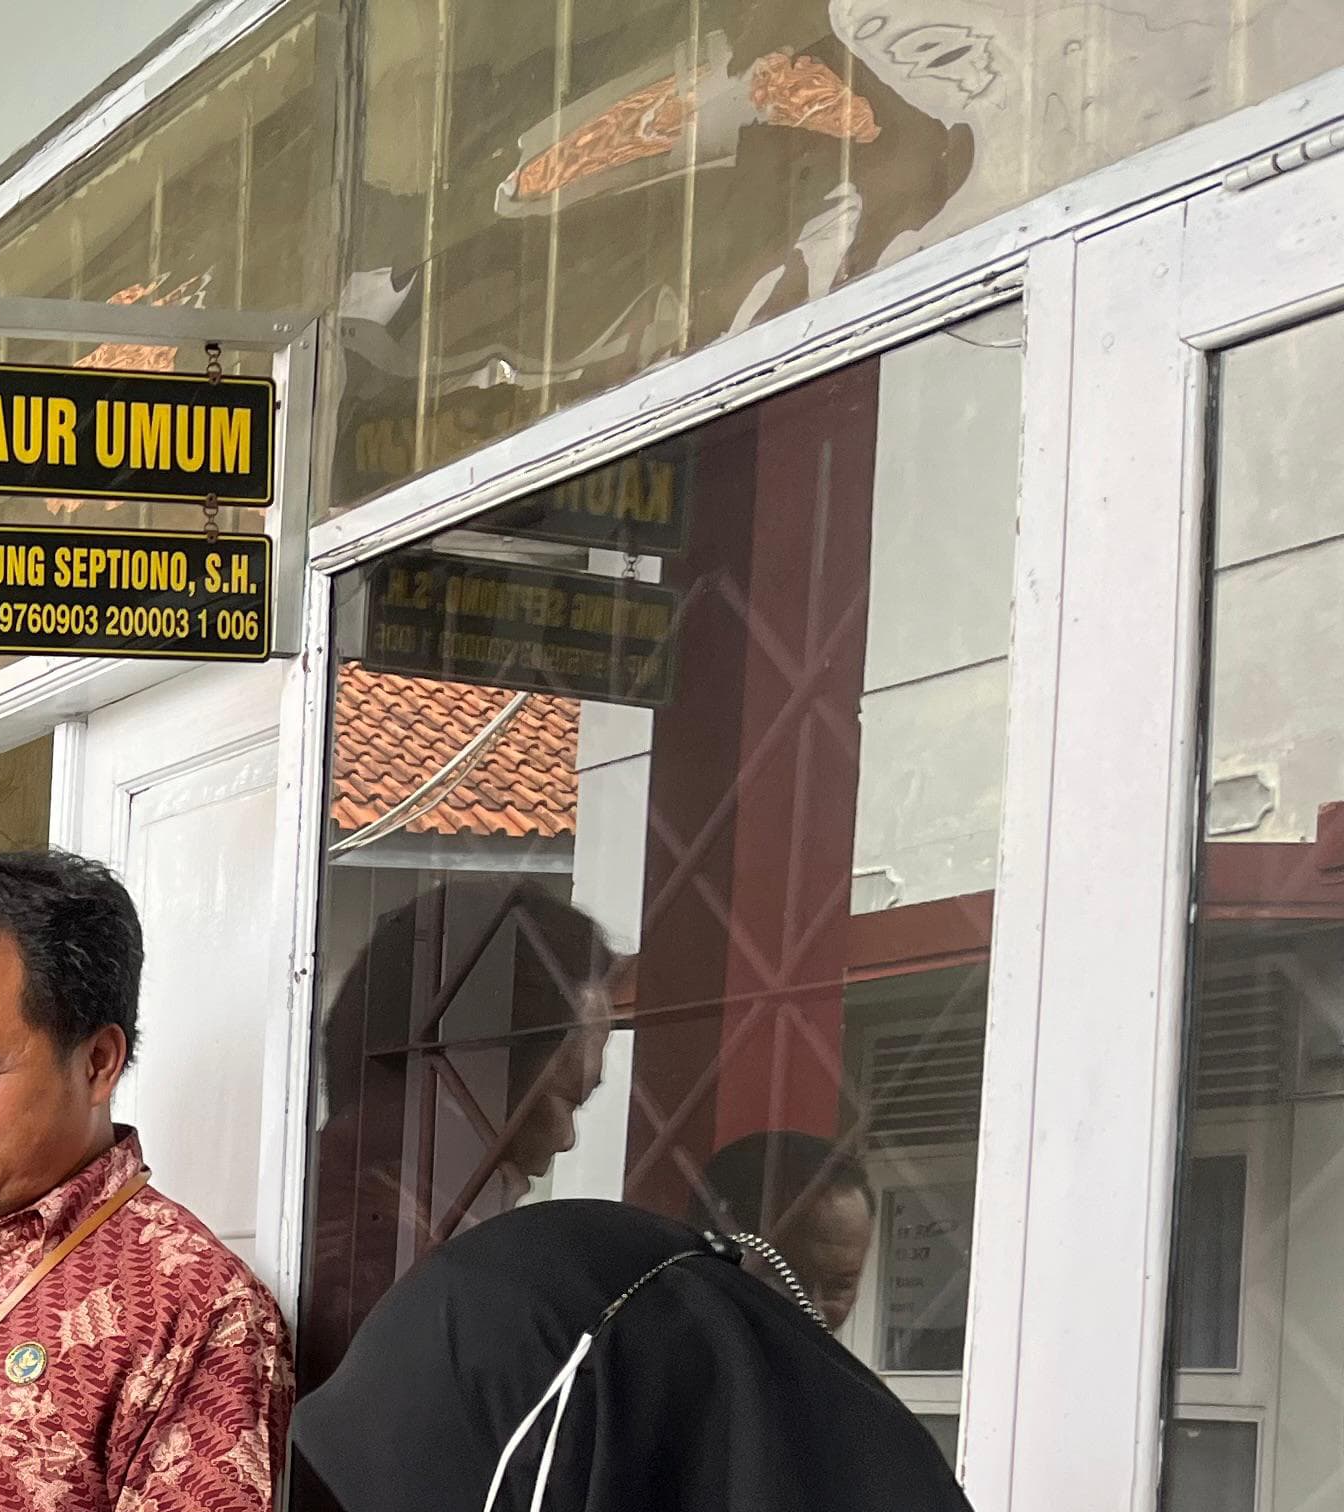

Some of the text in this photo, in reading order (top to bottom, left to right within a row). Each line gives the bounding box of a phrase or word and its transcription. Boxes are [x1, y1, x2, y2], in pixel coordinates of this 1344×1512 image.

[95, 400, 250, 474] UMUM
[54, 548, 196, 597] SEPTIONO,
[205, 554, 256, 594] S.H.
[106, 605, 189, 638] 200003
[198, 609, 206, 638] 1
[217, 610, 258, 641] 006
